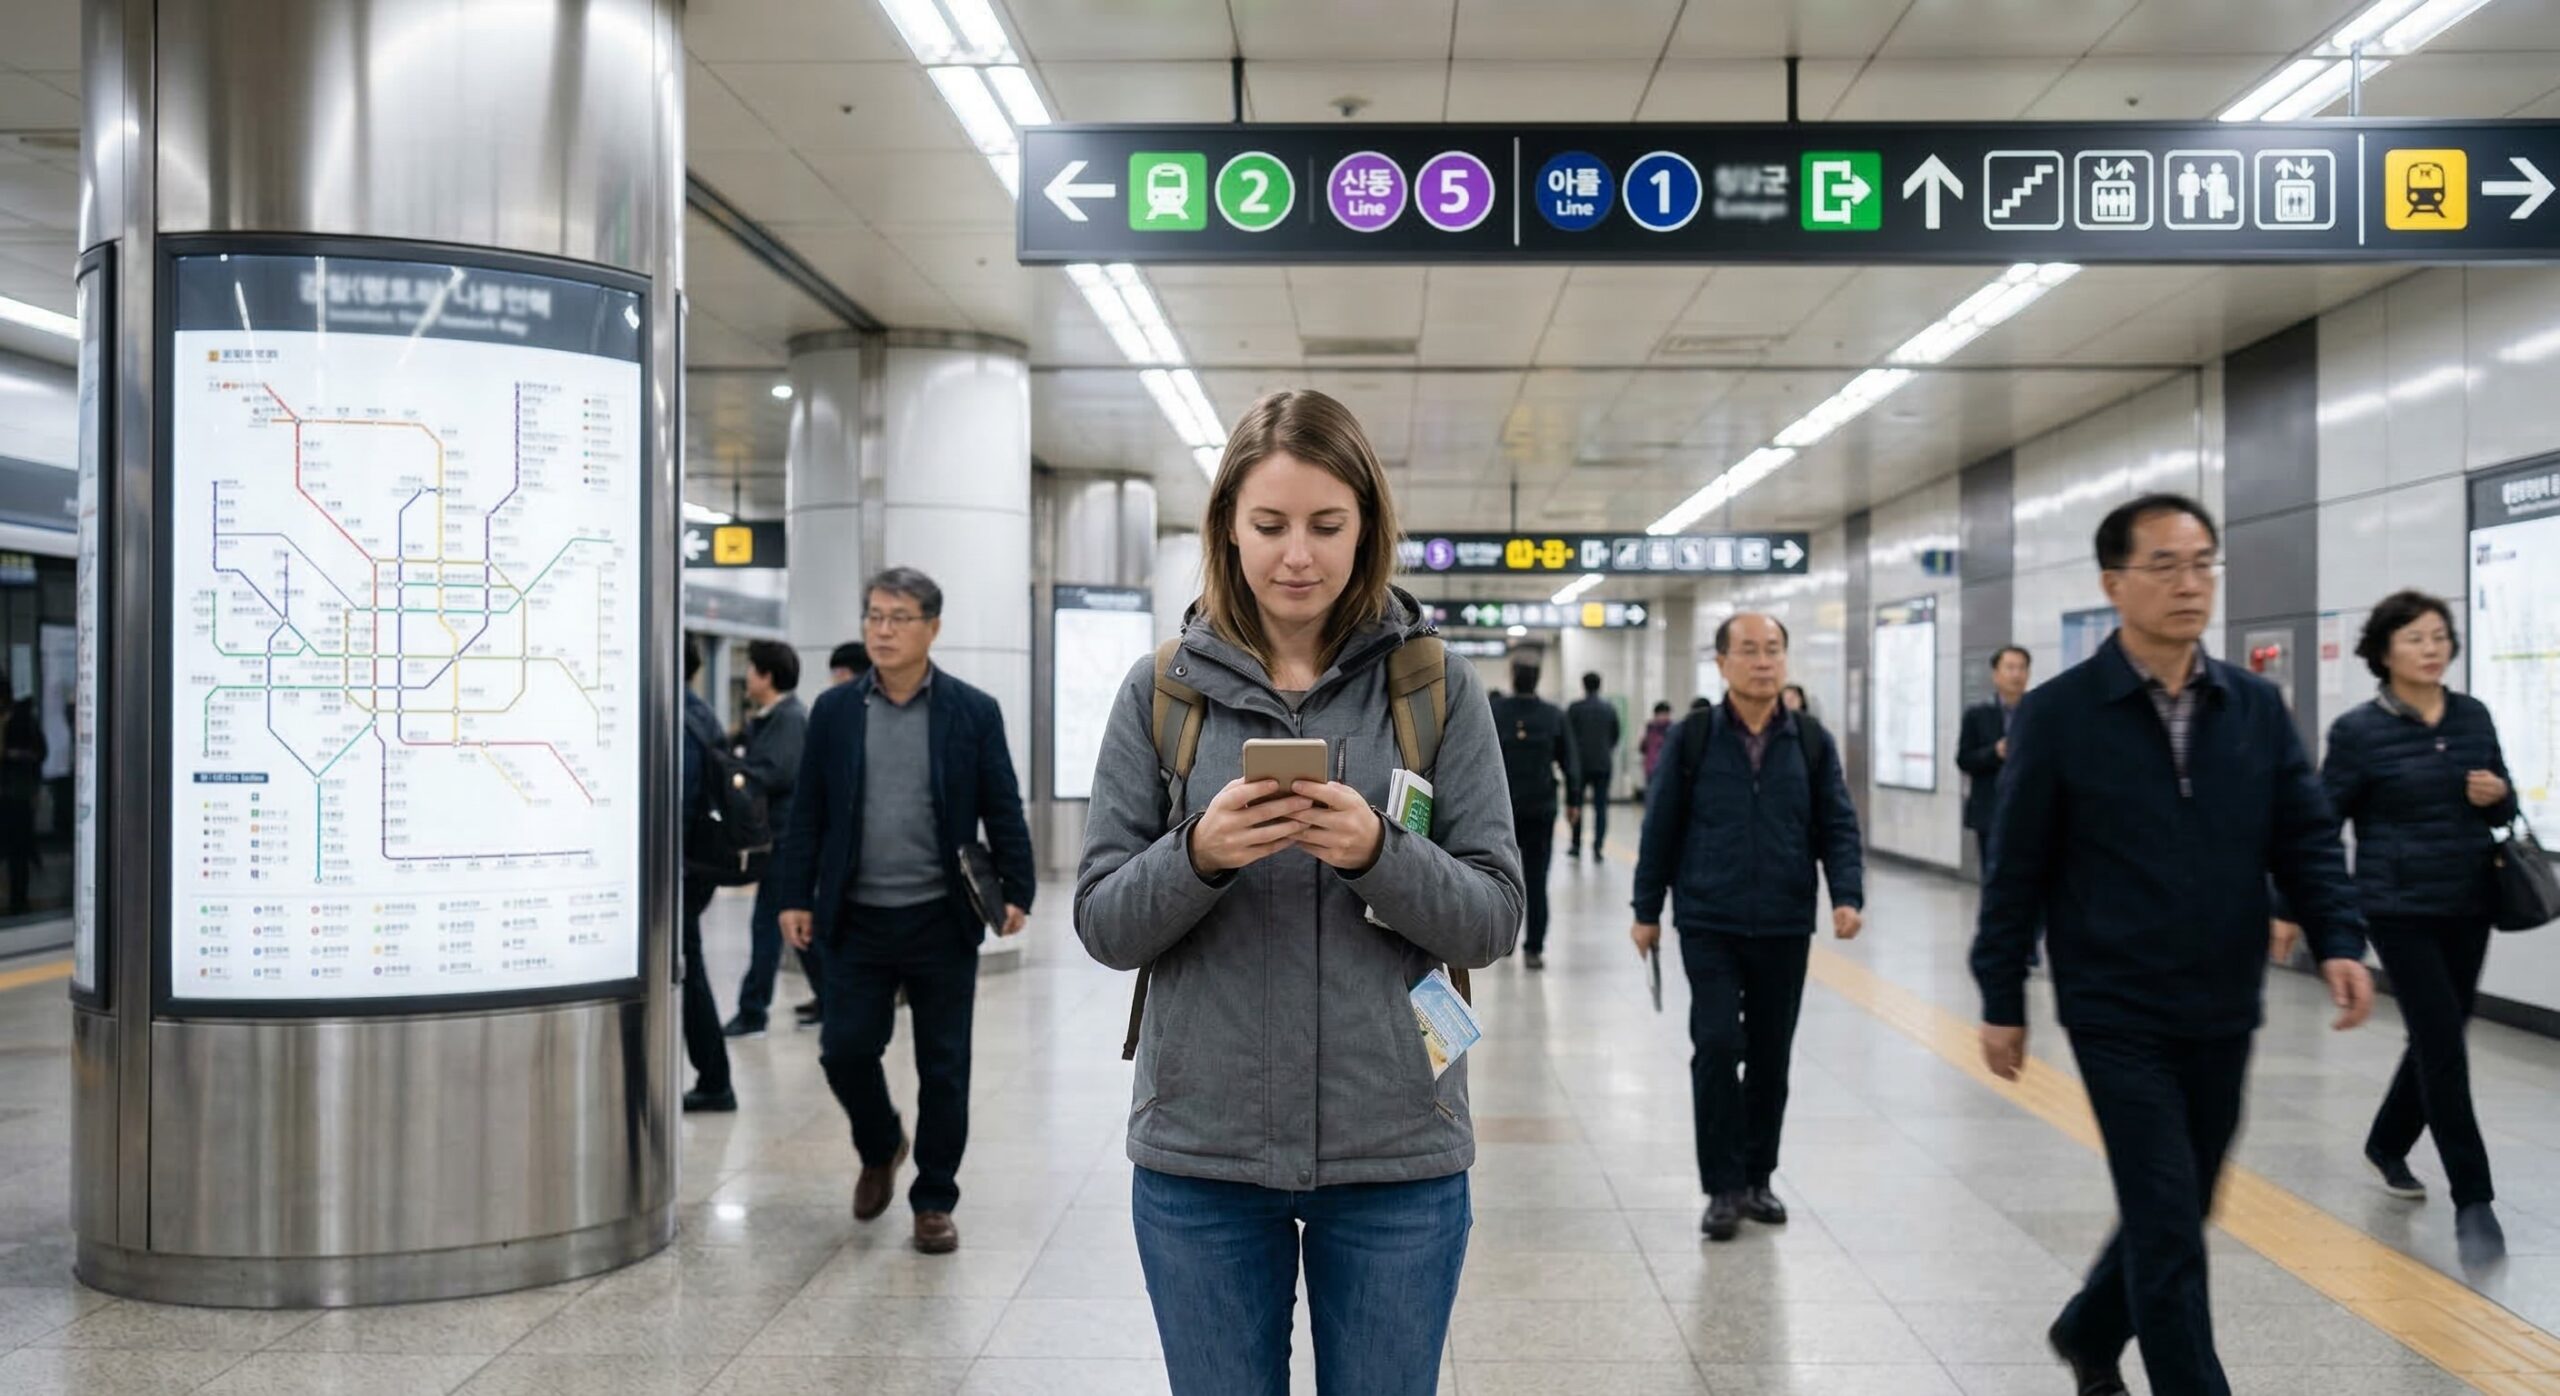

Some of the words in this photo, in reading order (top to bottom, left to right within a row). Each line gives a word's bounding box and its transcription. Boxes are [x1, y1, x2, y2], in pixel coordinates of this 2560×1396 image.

[1239, 169, 1270, 214] 2
[1340, 168, 1395, 198] 산동
[1440, 168, 1470, 214] 5
[1649, 169, 1671, 214] 1
[1348, 199, 1387, 216] Line
[1556, 199, 1595, 216] Line
